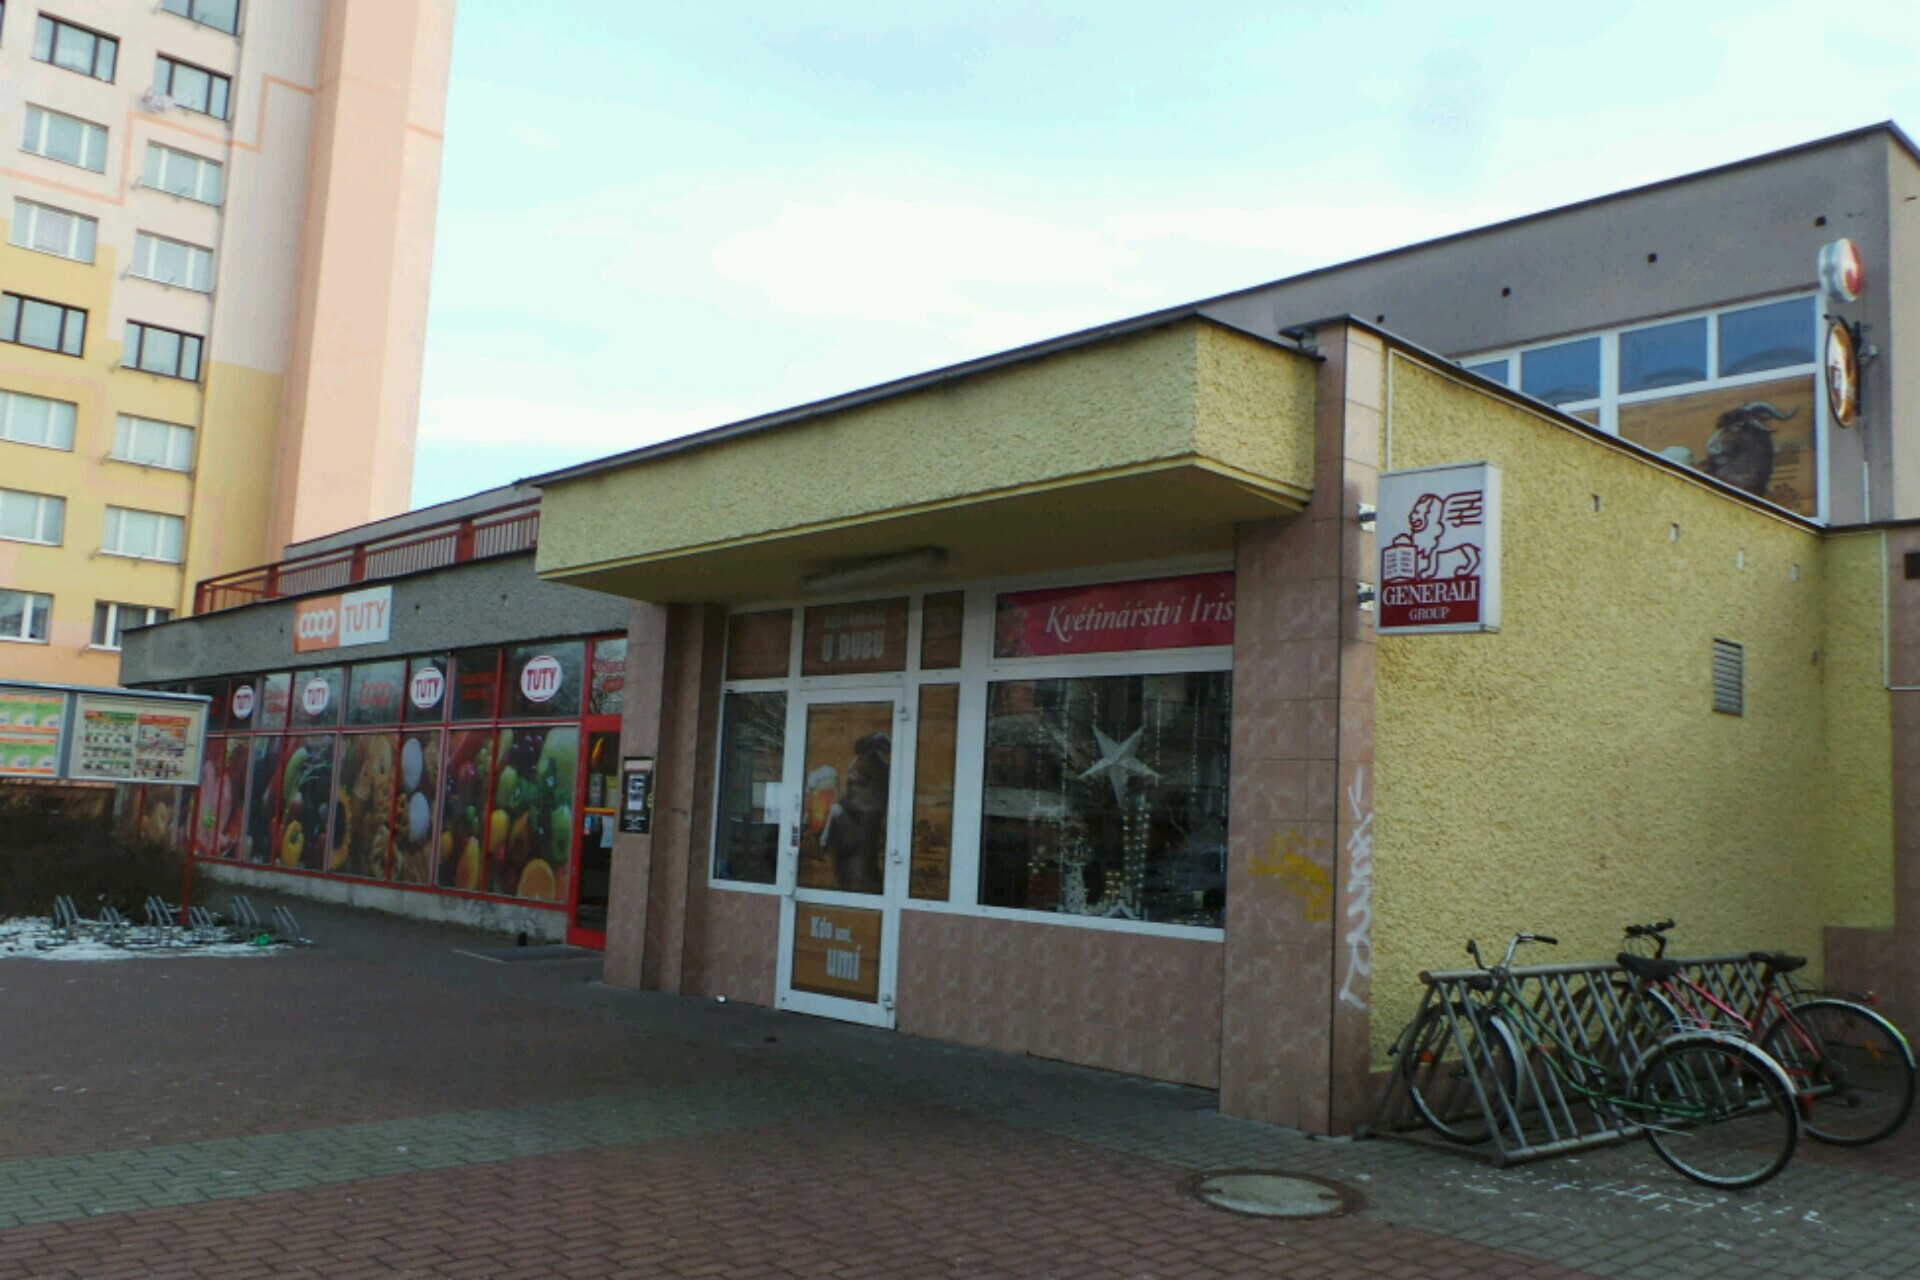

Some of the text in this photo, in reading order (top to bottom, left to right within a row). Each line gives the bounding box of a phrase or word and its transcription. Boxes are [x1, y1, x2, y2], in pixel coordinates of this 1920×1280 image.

[1383, 581, 1477, 605] GENERALI
[1190, 592, 1234, 624] Iris
[1409, 608, 1449, 620] GROUP
[299, 599, 388, 643] coop TUTY
[821, 630, 886, 662] U DUBU
[415, 677, 440, 699] TUTY
[527, 667, 557, 692] TUTY
[811, 916, 832, 938] Kdo
